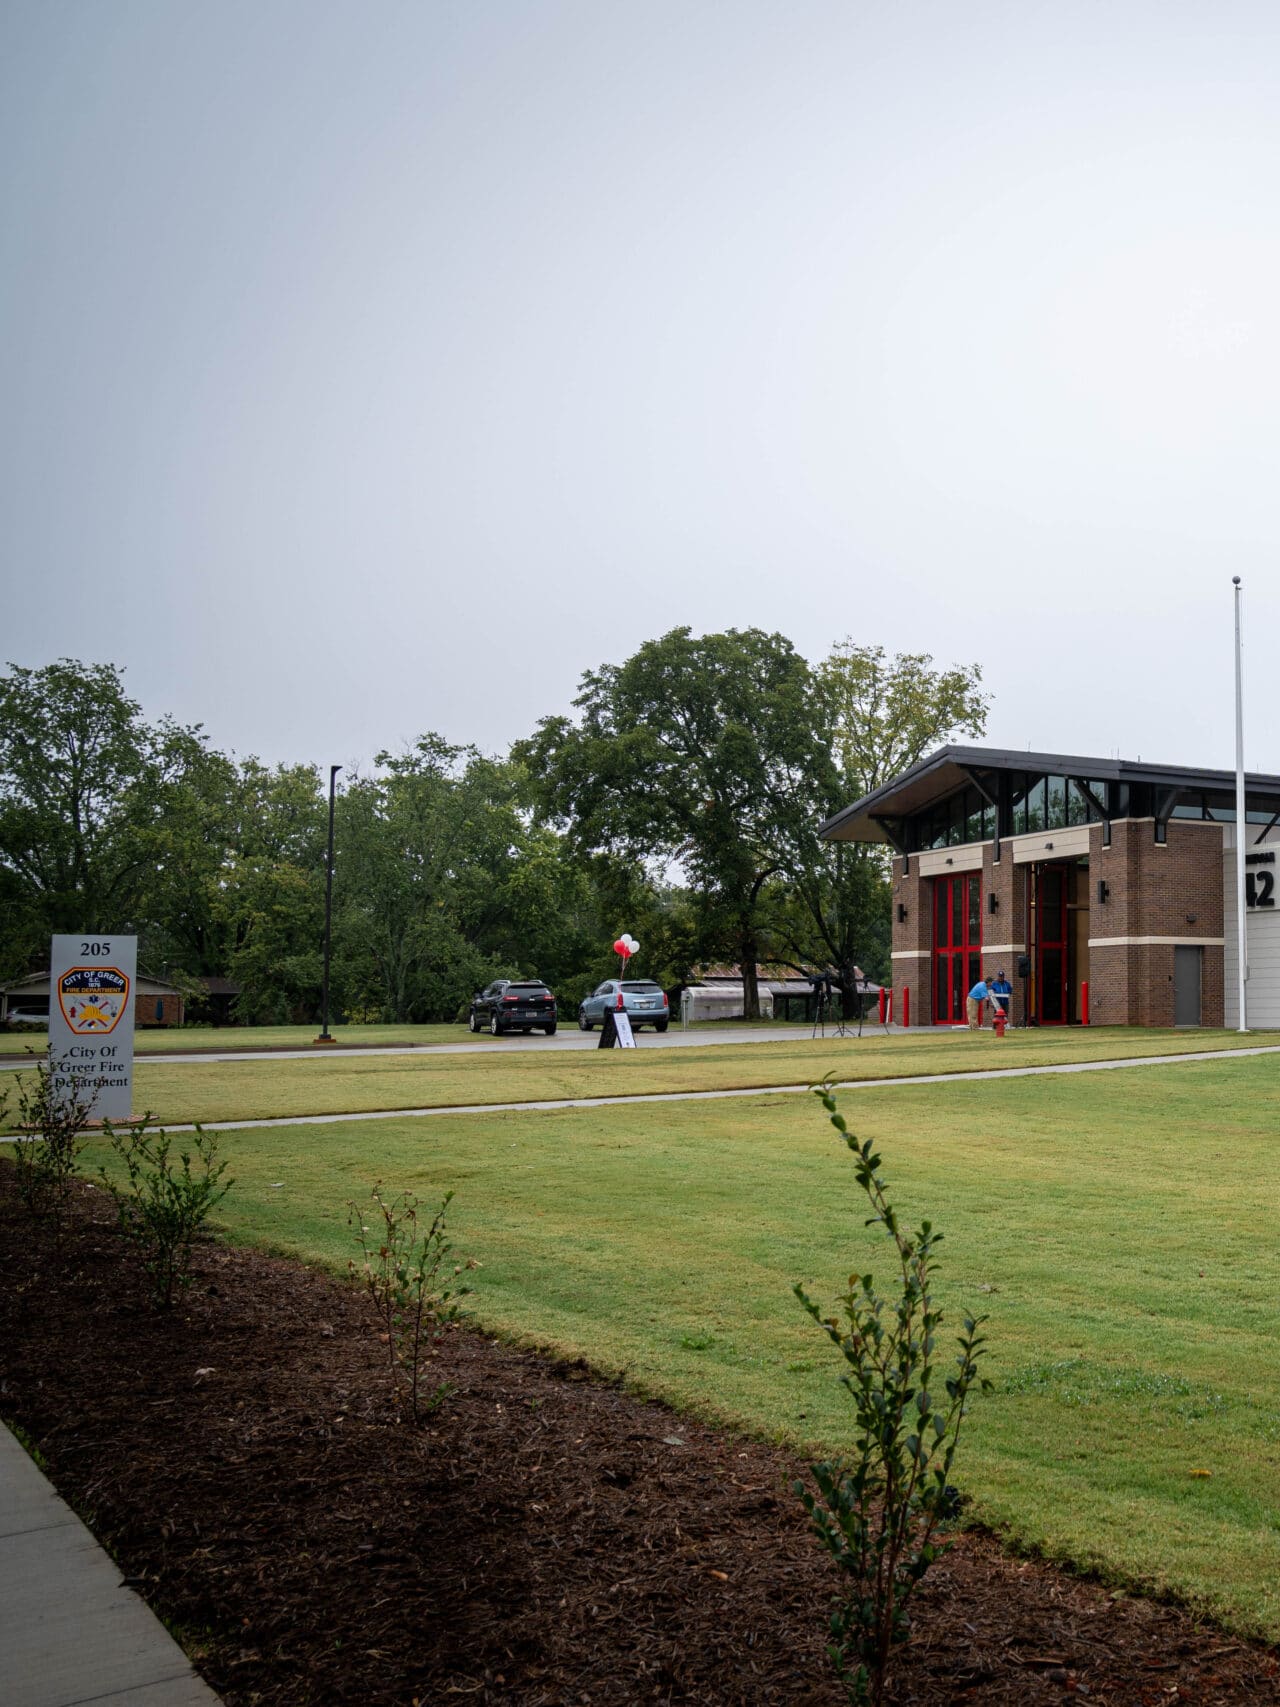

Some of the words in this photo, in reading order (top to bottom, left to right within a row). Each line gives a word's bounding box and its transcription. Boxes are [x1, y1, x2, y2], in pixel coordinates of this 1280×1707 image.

[80, 942, 111, 956] 205
[64, 972, 81, 986] CITY
[97, 971, 125, 986] GREER
[70, 1046, 96, 1059] City
[100, 1046, 118, 1057] Of
[60, 1061, 97, 1073] Greer
[100, 1061, 125, 1072] Fire
[55, 1076, 129, 1090] Deartment
